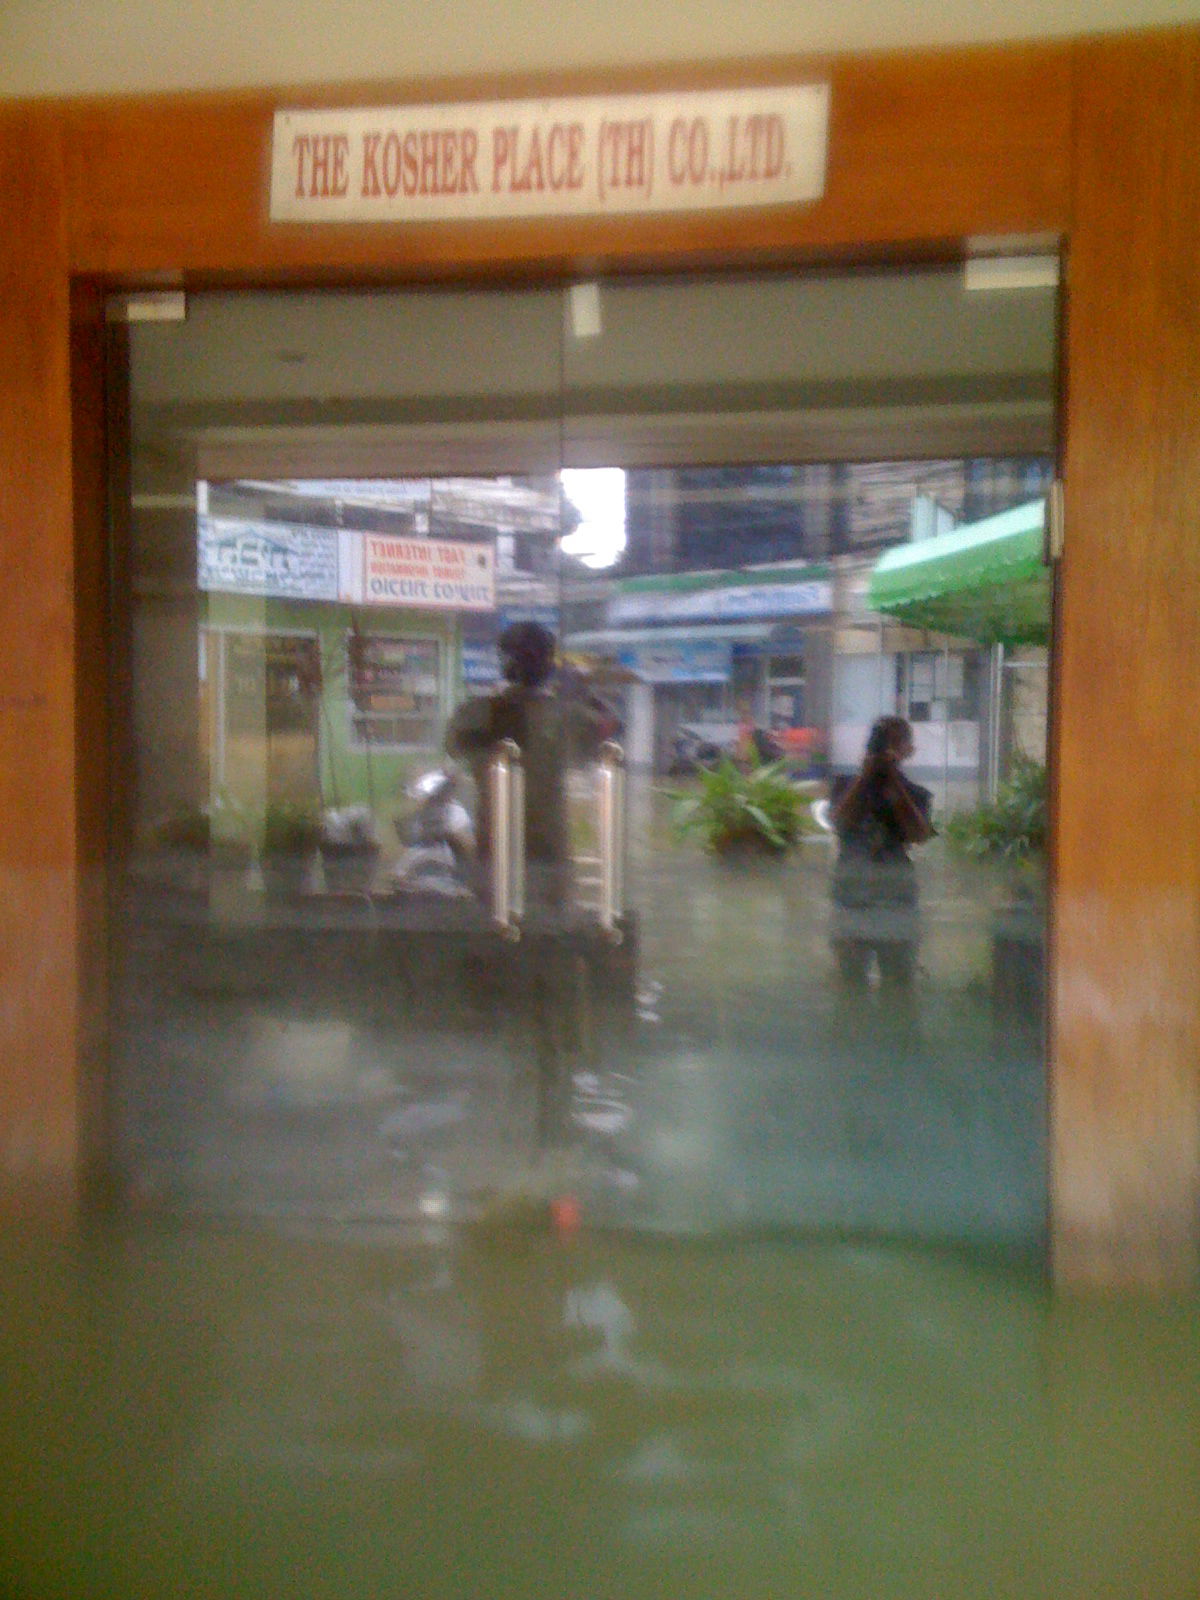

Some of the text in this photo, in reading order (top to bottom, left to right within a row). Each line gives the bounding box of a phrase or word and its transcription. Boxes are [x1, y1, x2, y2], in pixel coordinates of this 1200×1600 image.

[294, 134, 349, 198] THE
[361, 128, 479, 197] KOSHER
[492, 121, 585, 193] PLACE
